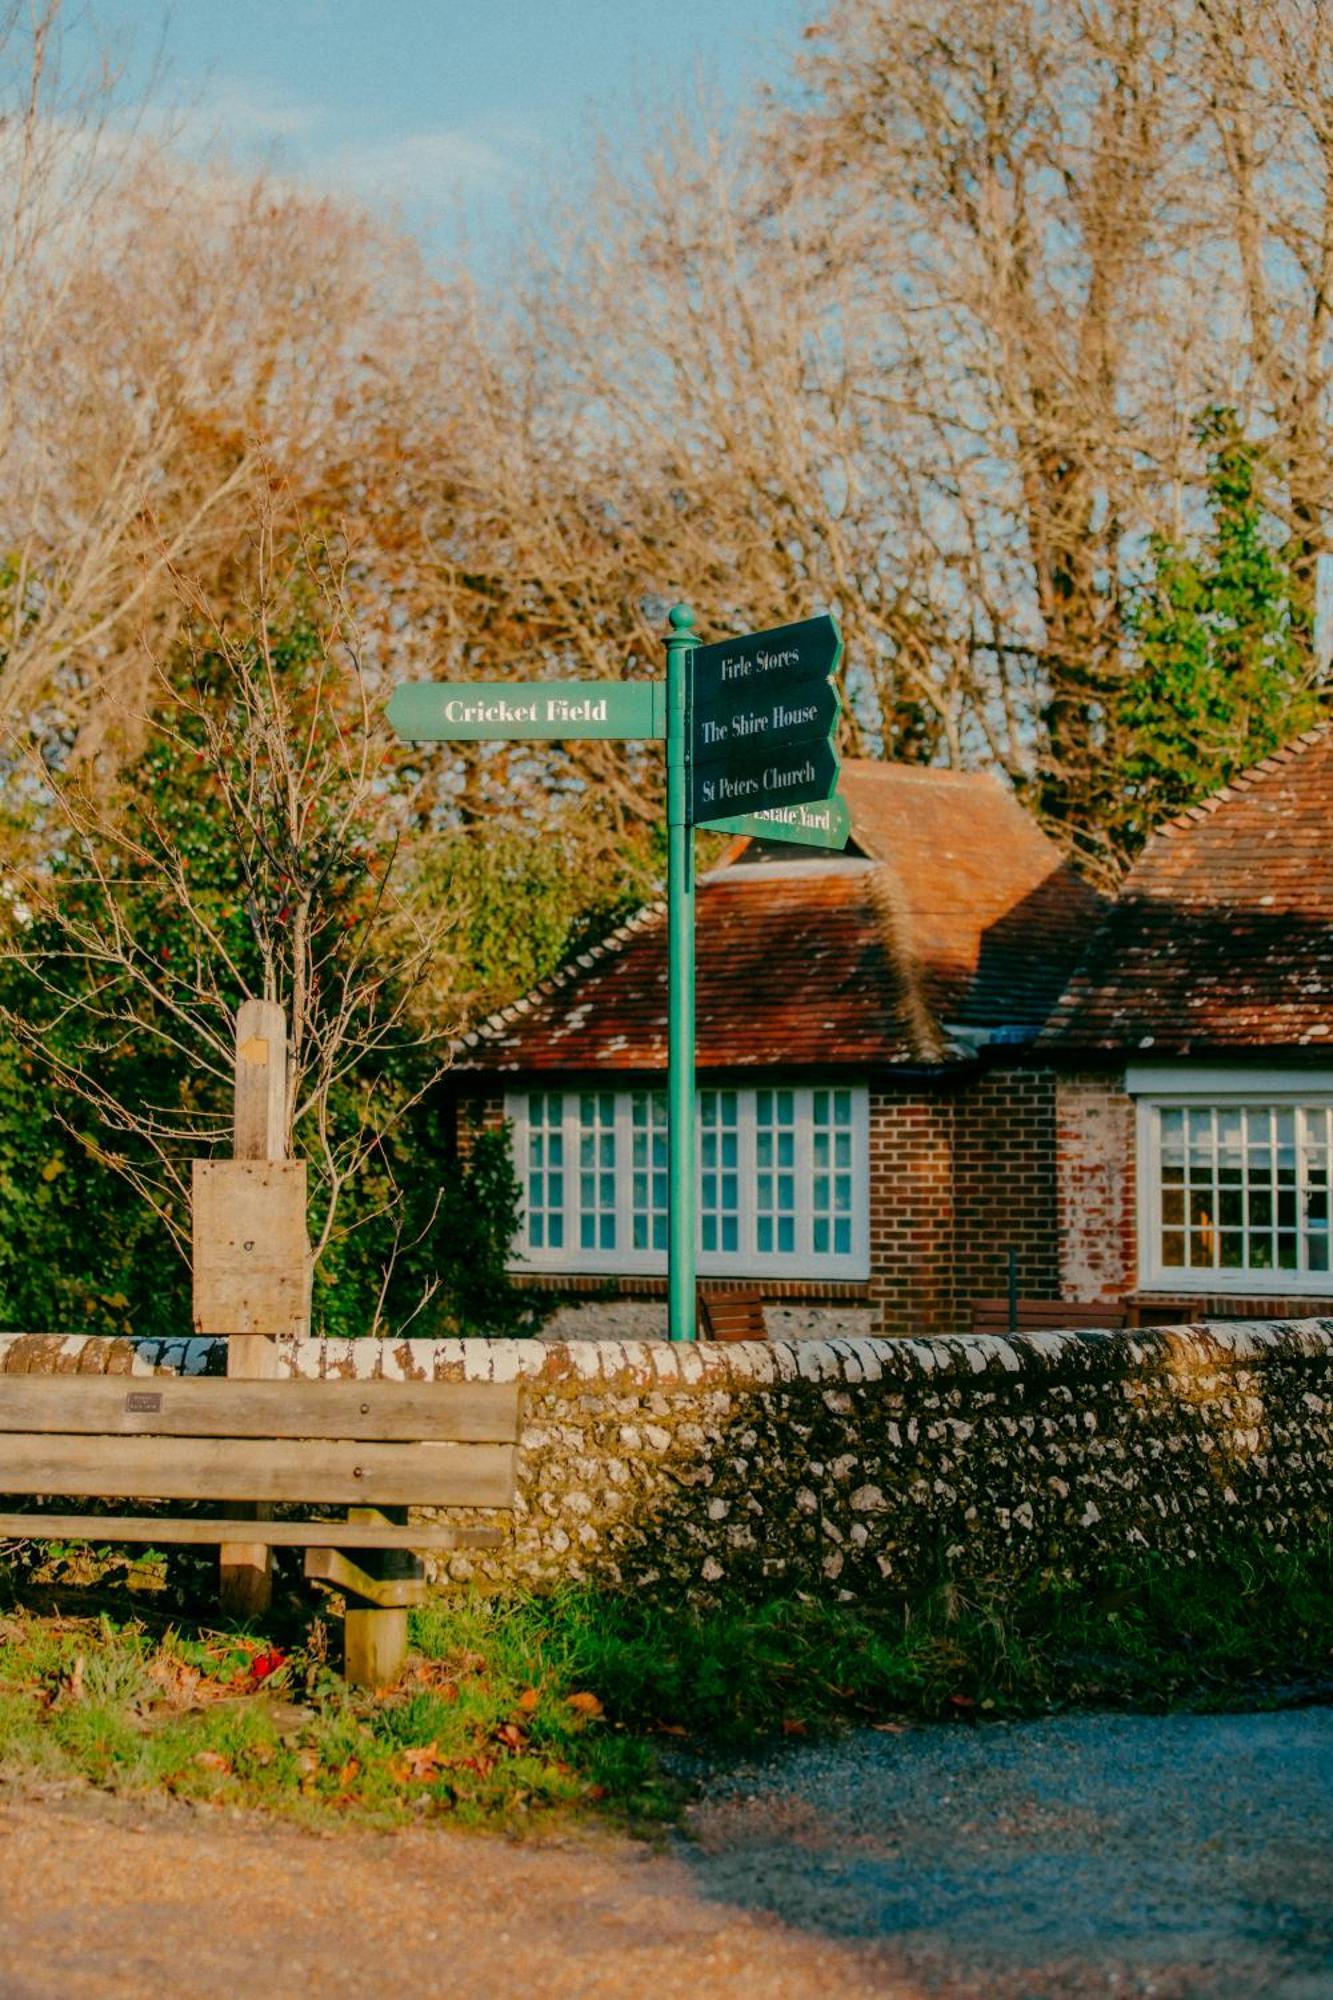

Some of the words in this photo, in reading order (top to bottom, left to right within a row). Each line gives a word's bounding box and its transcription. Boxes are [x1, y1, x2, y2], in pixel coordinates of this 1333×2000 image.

[721, 656, 752, 680] Firle
[756, 648, 799, 672] Stores
[445, 700, 538, 722] Cricket
[547, 700, 607, 721] Field
[702, 721, 728, 744] The
[732, 712, 769, 737] Shire
[773, 705, 818, 729] House
[703, 779, 714, 802] St
[719, 778, 759, 798] Peters
[763, 761, 816, 790] Church
[799, 804, 830, 829] Yard
